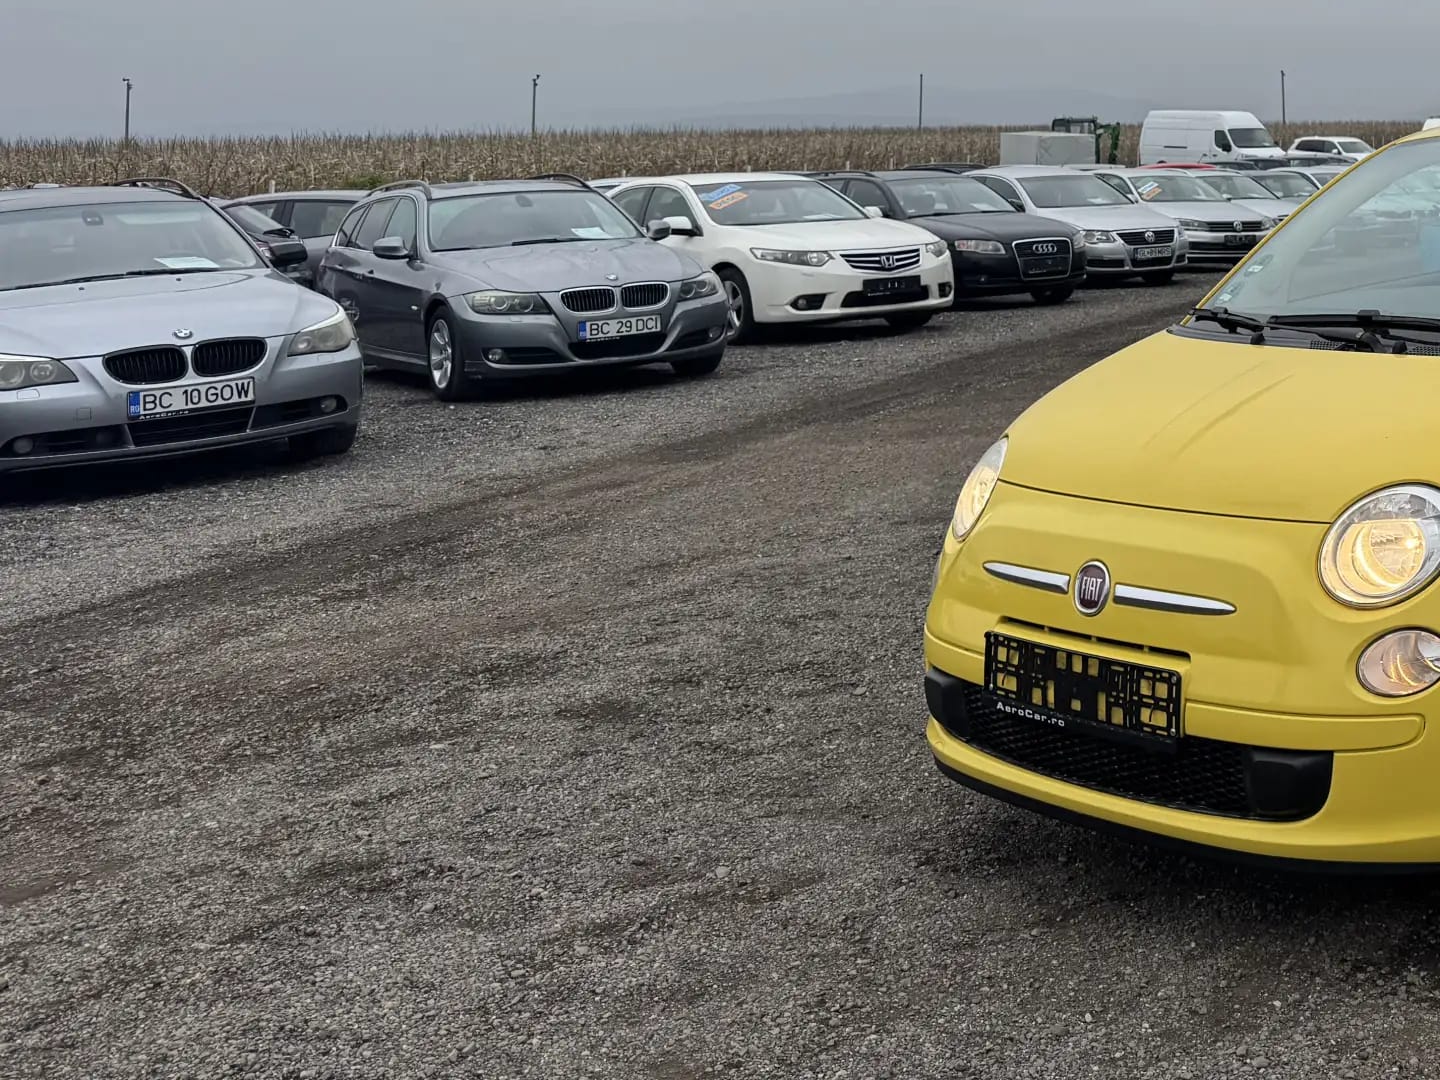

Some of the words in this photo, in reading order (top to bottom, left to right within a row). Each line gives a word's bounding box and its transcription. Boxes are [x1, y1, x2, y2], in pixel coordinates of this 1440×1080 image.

[589, 322, 610, 336] BC
[615, 320, 633, 334] 29
[635, 316, 658, 332] DCI
[142, 391, 173, 412] BC
[182, 388, 201, 407] 10
[205, 381, 250, 403] GOW
[1080, 576, 1103, 601] FIAT
[996, 701, 1065, 726] AeroCar.ro
